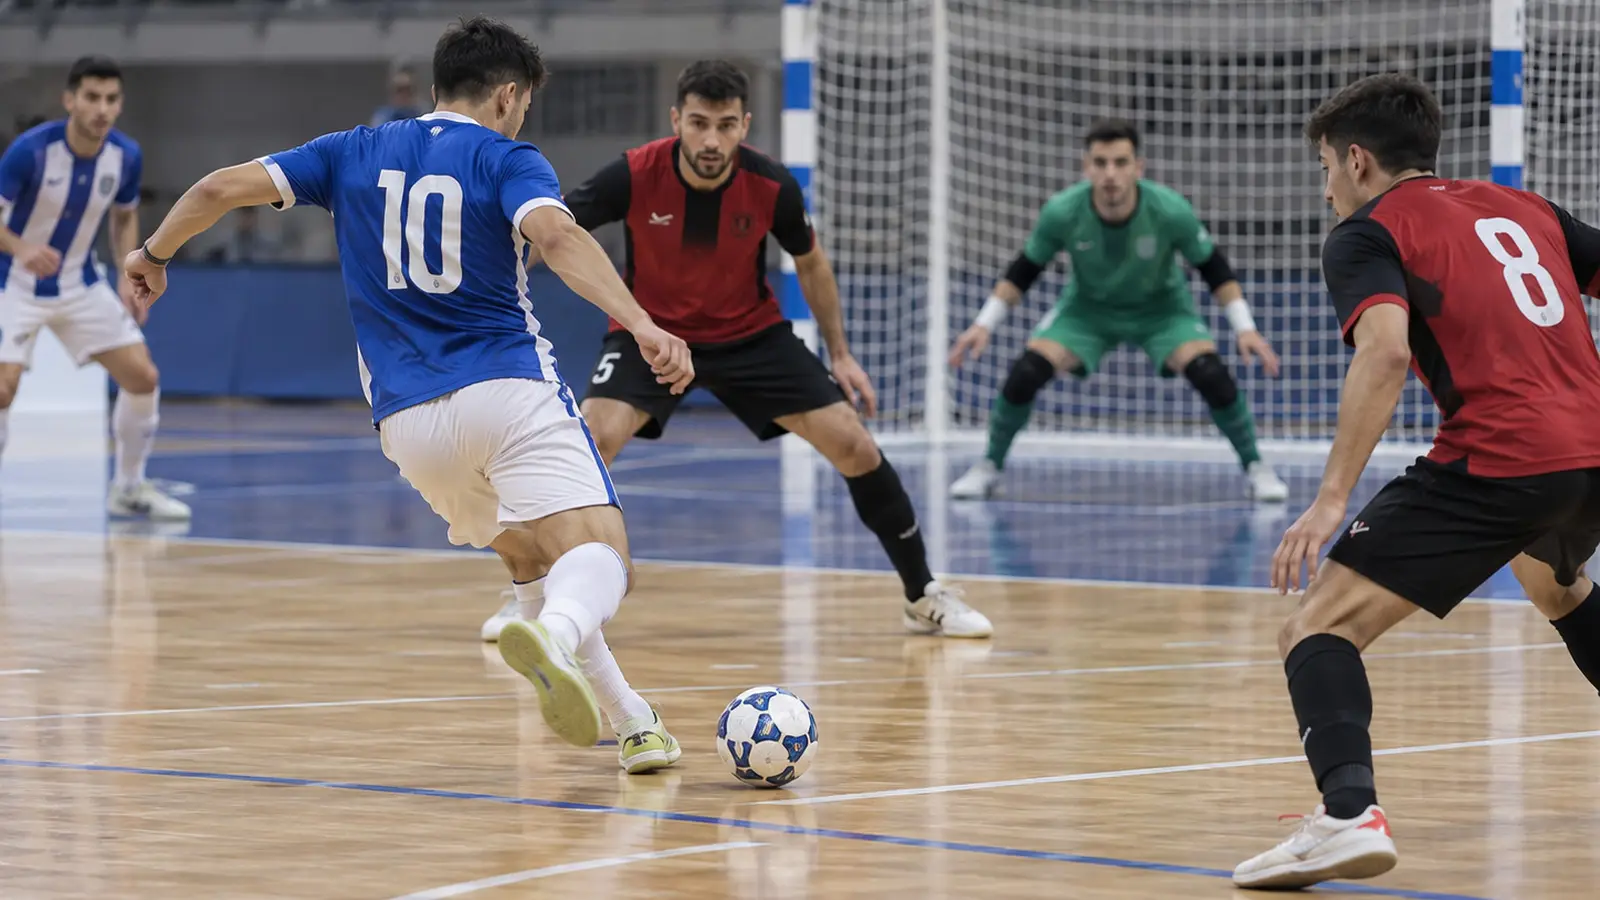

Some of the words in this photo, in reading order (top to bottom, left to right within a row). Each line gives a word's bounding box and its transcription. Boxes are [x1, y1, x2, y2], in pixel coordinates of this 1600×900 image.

[377, 169, 463, 294] 10
[1474, 217, 1565, 327] 8
[592, 352, 621, 384] 5
